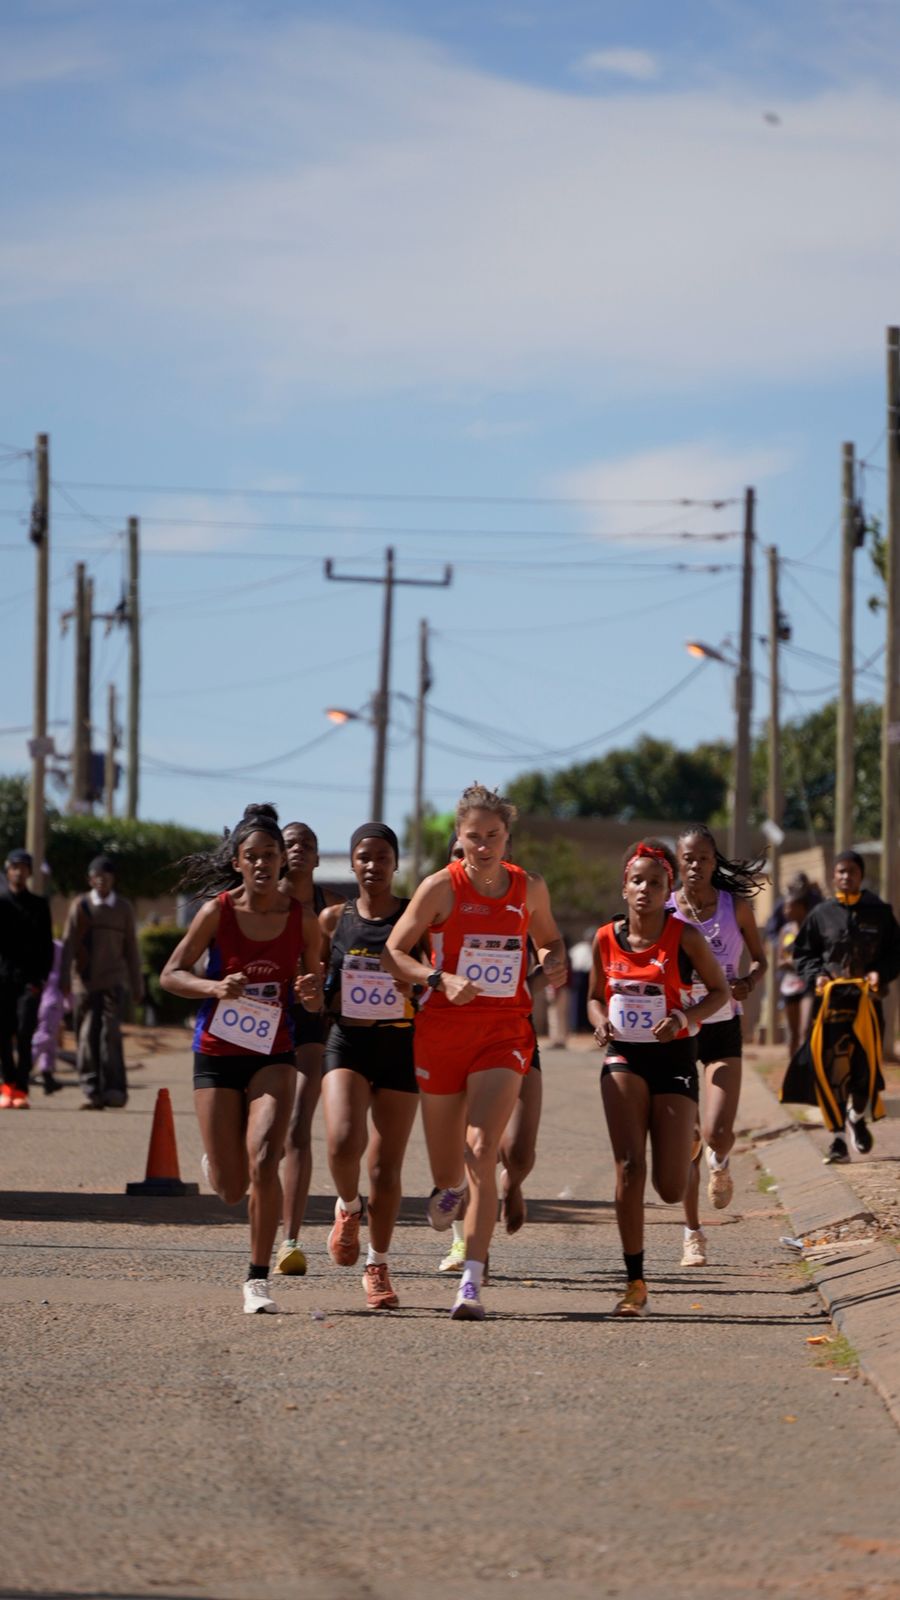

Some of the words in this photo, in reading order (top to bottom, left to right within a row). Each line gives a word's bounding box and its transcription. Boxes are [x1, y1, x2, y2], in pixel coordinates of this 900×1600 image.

[466, 964, 513, 984] 005
[350, 986, 397, 1005] 066
[223, 1008, 271, 1038] 008
[619, 1010, 653, 1029] 193
